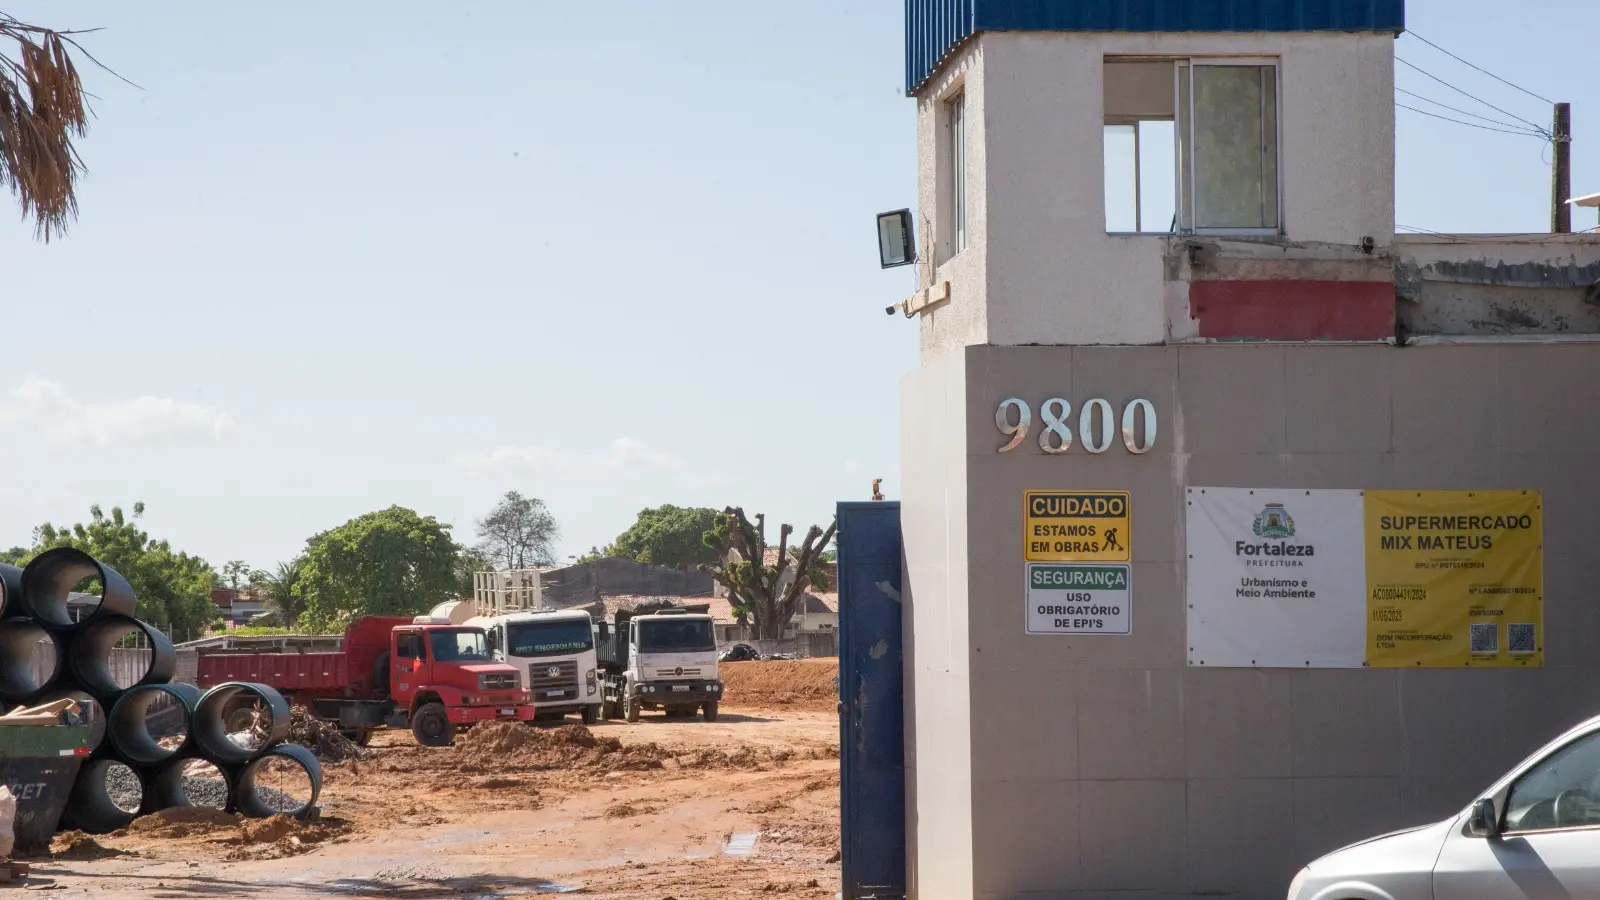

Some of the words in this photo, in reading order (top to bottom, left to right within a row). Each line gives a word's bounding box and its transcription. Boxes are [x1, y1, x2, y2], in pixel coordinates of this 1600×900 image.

[995, 397, 1157, 454] 9800
[1032, 498, 1124, 515] CUIDADO
[1380, 514, 1532, 530] SUPERMERCADO
[1033, 525, 1096, 537] ESTAMOS
[1031, 541, 1050, 553] EM
[1054, 541, 1099, 553] OBRAS
[1236, 540, 1314, 557] Fortaleza
[1381, 535, 1412, 550] MIX
[1417, 535, 1492, 550] MATEUS
[1246, 559, 1304, 567] PREFEITURA
[1033, 571, 1126, 589] SEGURANÇA
[1241, 577, 1299, 588] Urbanismo
[1301, 579, 1308, 588] e
[1066, 592, 1091, 602] USO
[1236, 588, 1261, 598] Meio
[1263, 588, 1316, 599] Ambiente
[1037, 603, 1120, 616] OBRIGATÓRIO
[1054, 619, 1070, 628] DE
[1073, 619, 1104, 629] EPI'S
